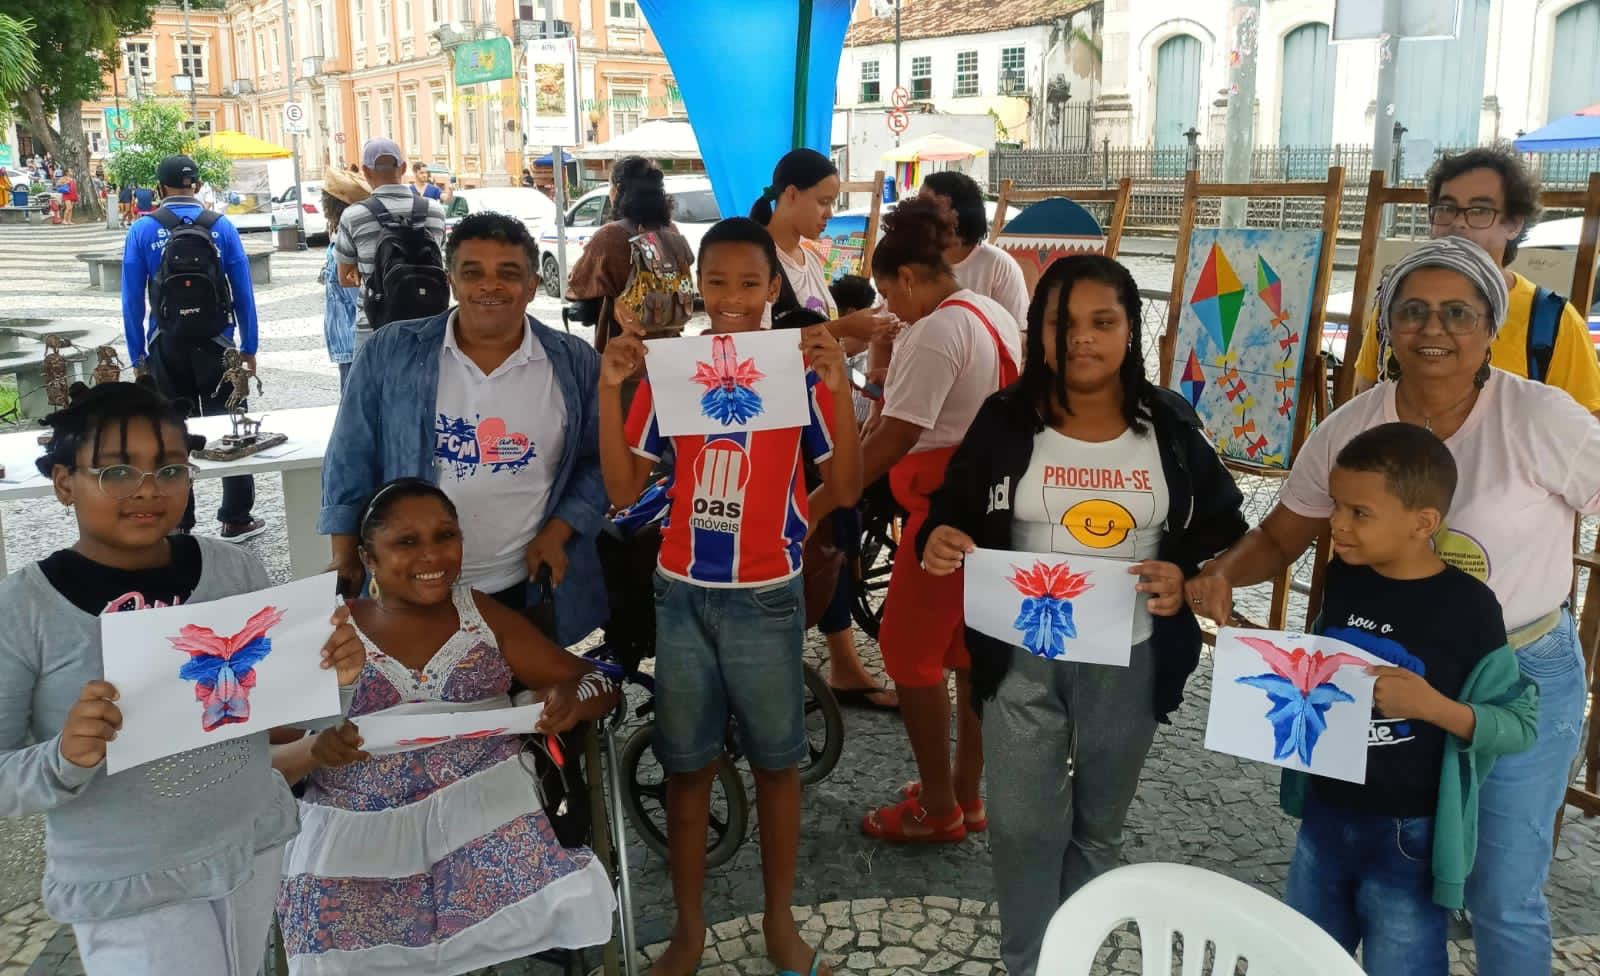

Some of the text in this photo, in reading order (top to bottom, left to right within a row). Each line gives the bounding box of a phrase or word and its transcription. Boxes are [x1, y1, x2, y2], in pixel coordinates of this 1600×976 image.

[436, 433, 476, 459] FCM
[1043, 465, 1152, 490] PROCURA-SE
[693, 498, 741, 518] oas
[690, 517, 739, 533] imóveis
[1347, 614, 1393, 634] sou o
